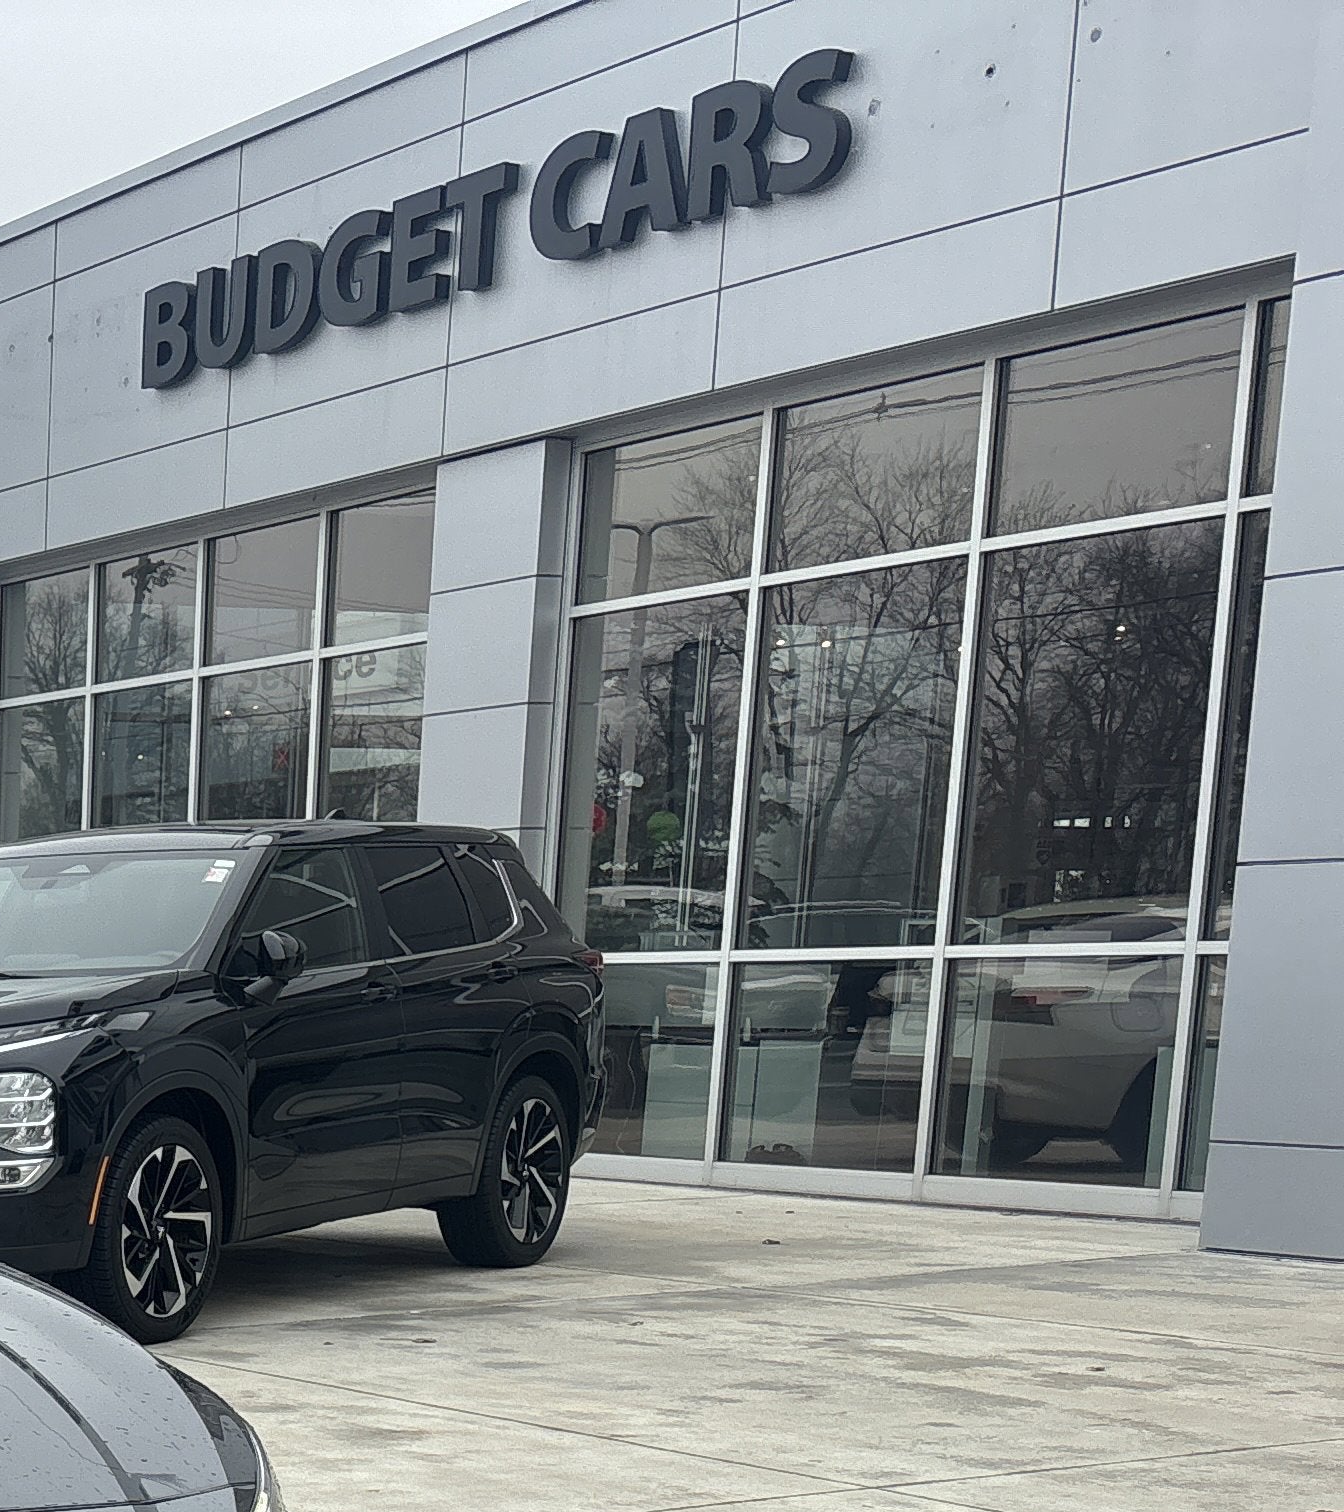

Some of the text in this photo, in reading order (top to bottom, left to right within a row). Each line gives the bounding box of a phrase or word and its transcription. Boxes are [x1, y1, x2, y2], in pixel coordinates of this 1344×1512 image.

[141, 49, 855, 388] BUDGET CARS
[238, 652, 378, 692] Serce
